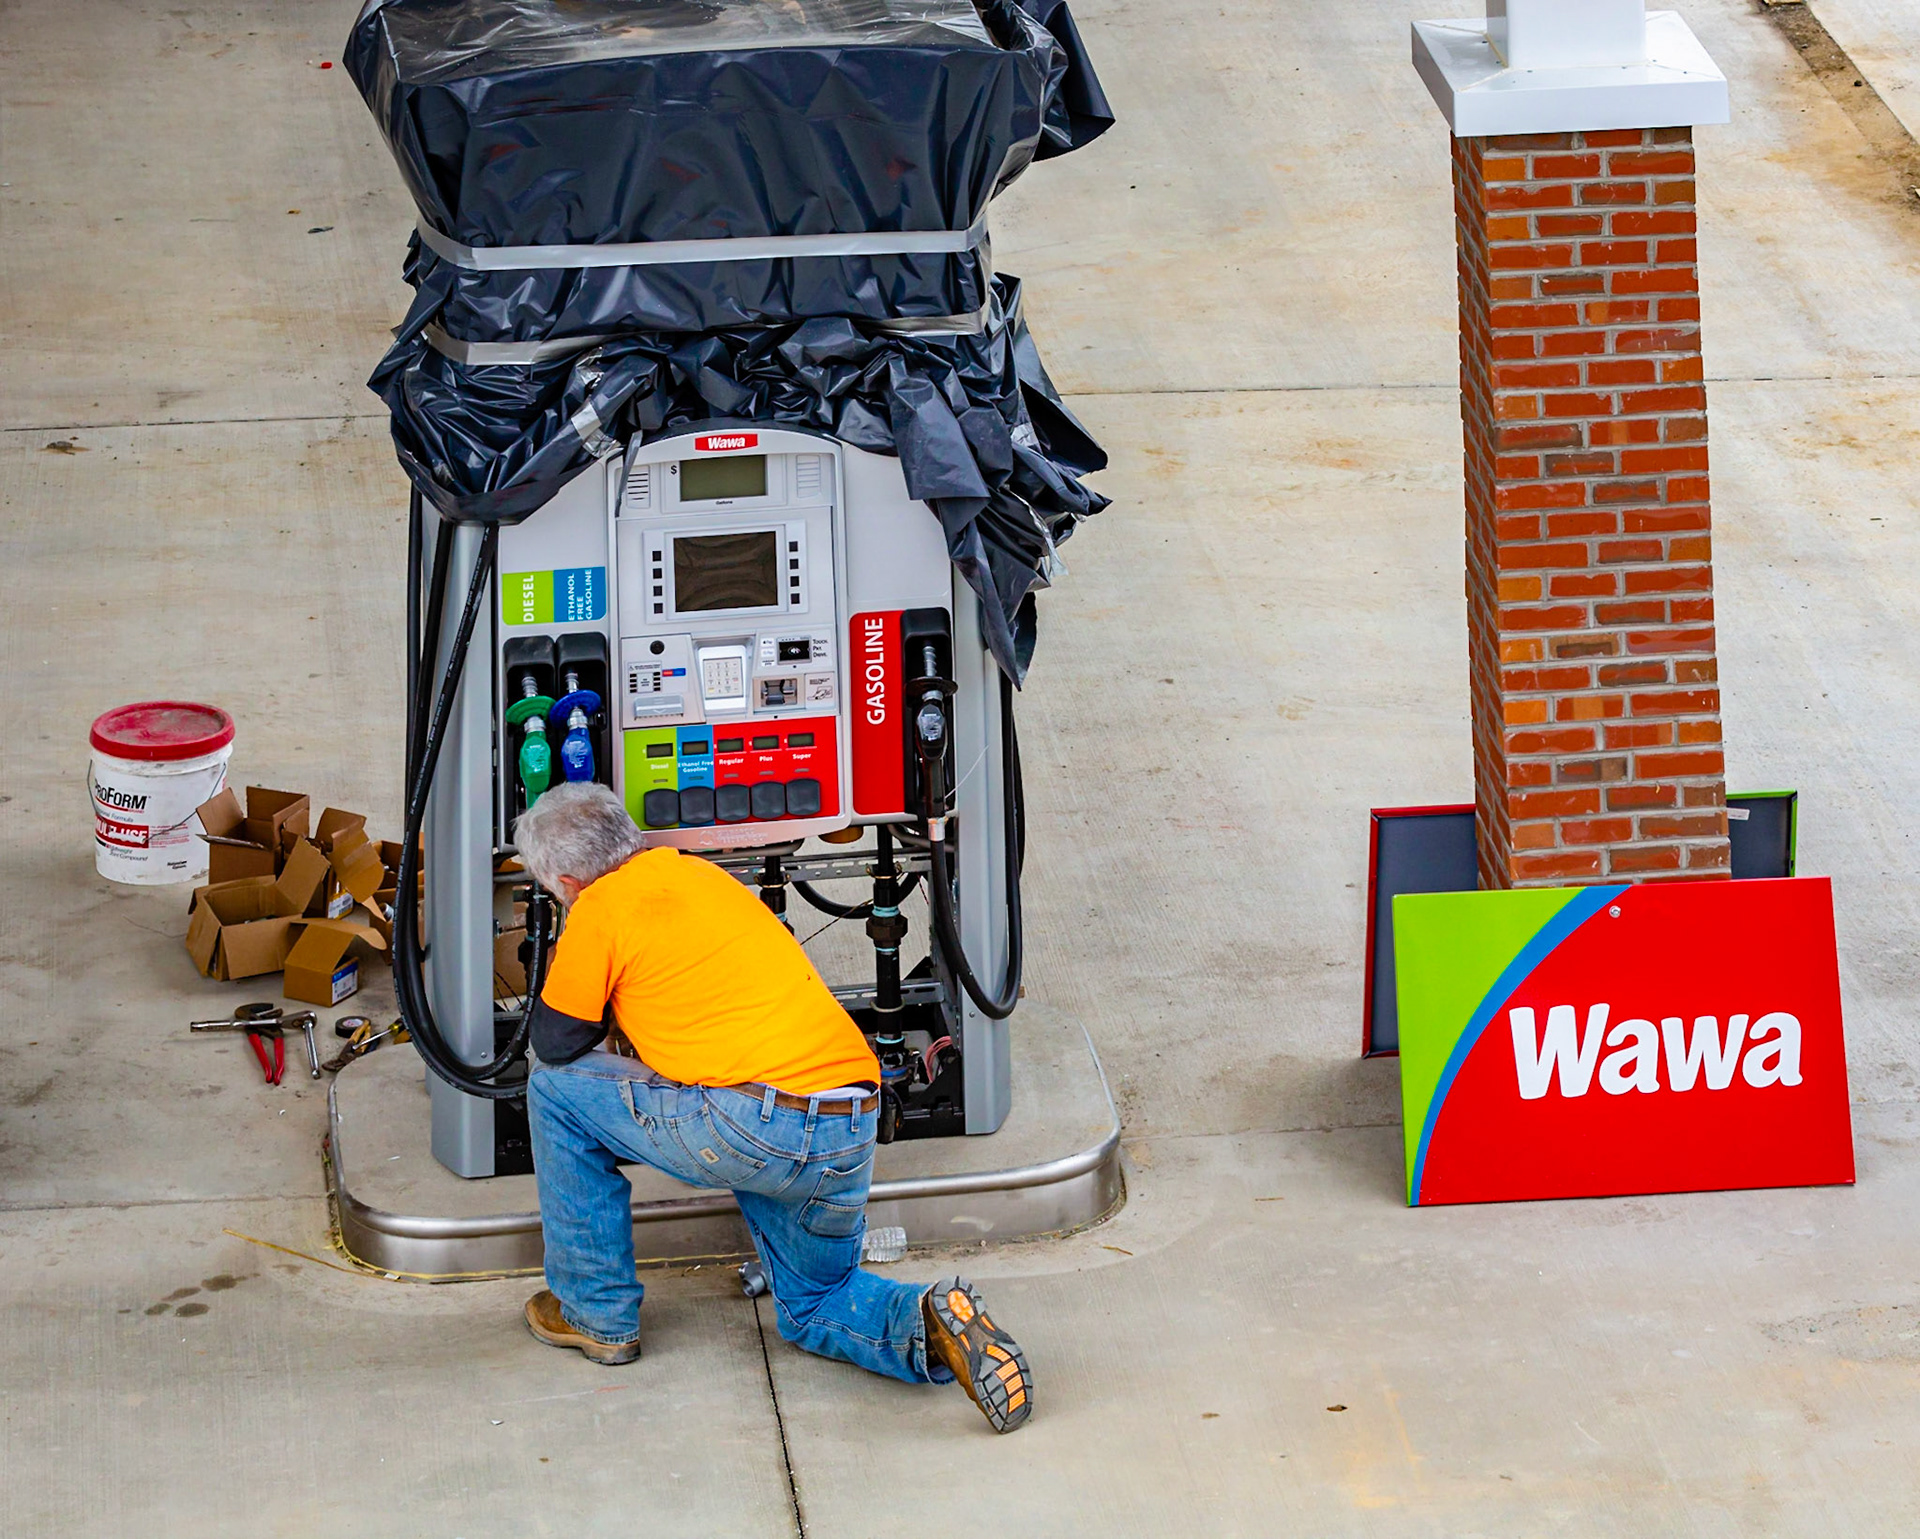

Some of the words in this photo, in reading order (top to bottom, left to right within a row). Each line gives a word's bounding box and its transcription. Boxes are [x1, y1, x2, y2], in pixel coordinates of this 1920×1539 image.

[707, 437, 745, 449] Wawa
[670, 465, 678, 475] $
[523, 575, 534, 622] DIESEL
[576, 596, 584, 620] FREE
[865, 618, 885, 725] GASOLINE
[719, 757, 744, 765] Regular
[792, 753, 812, 761] Super
[1509, 1003, 1803, 1100] Wawa
